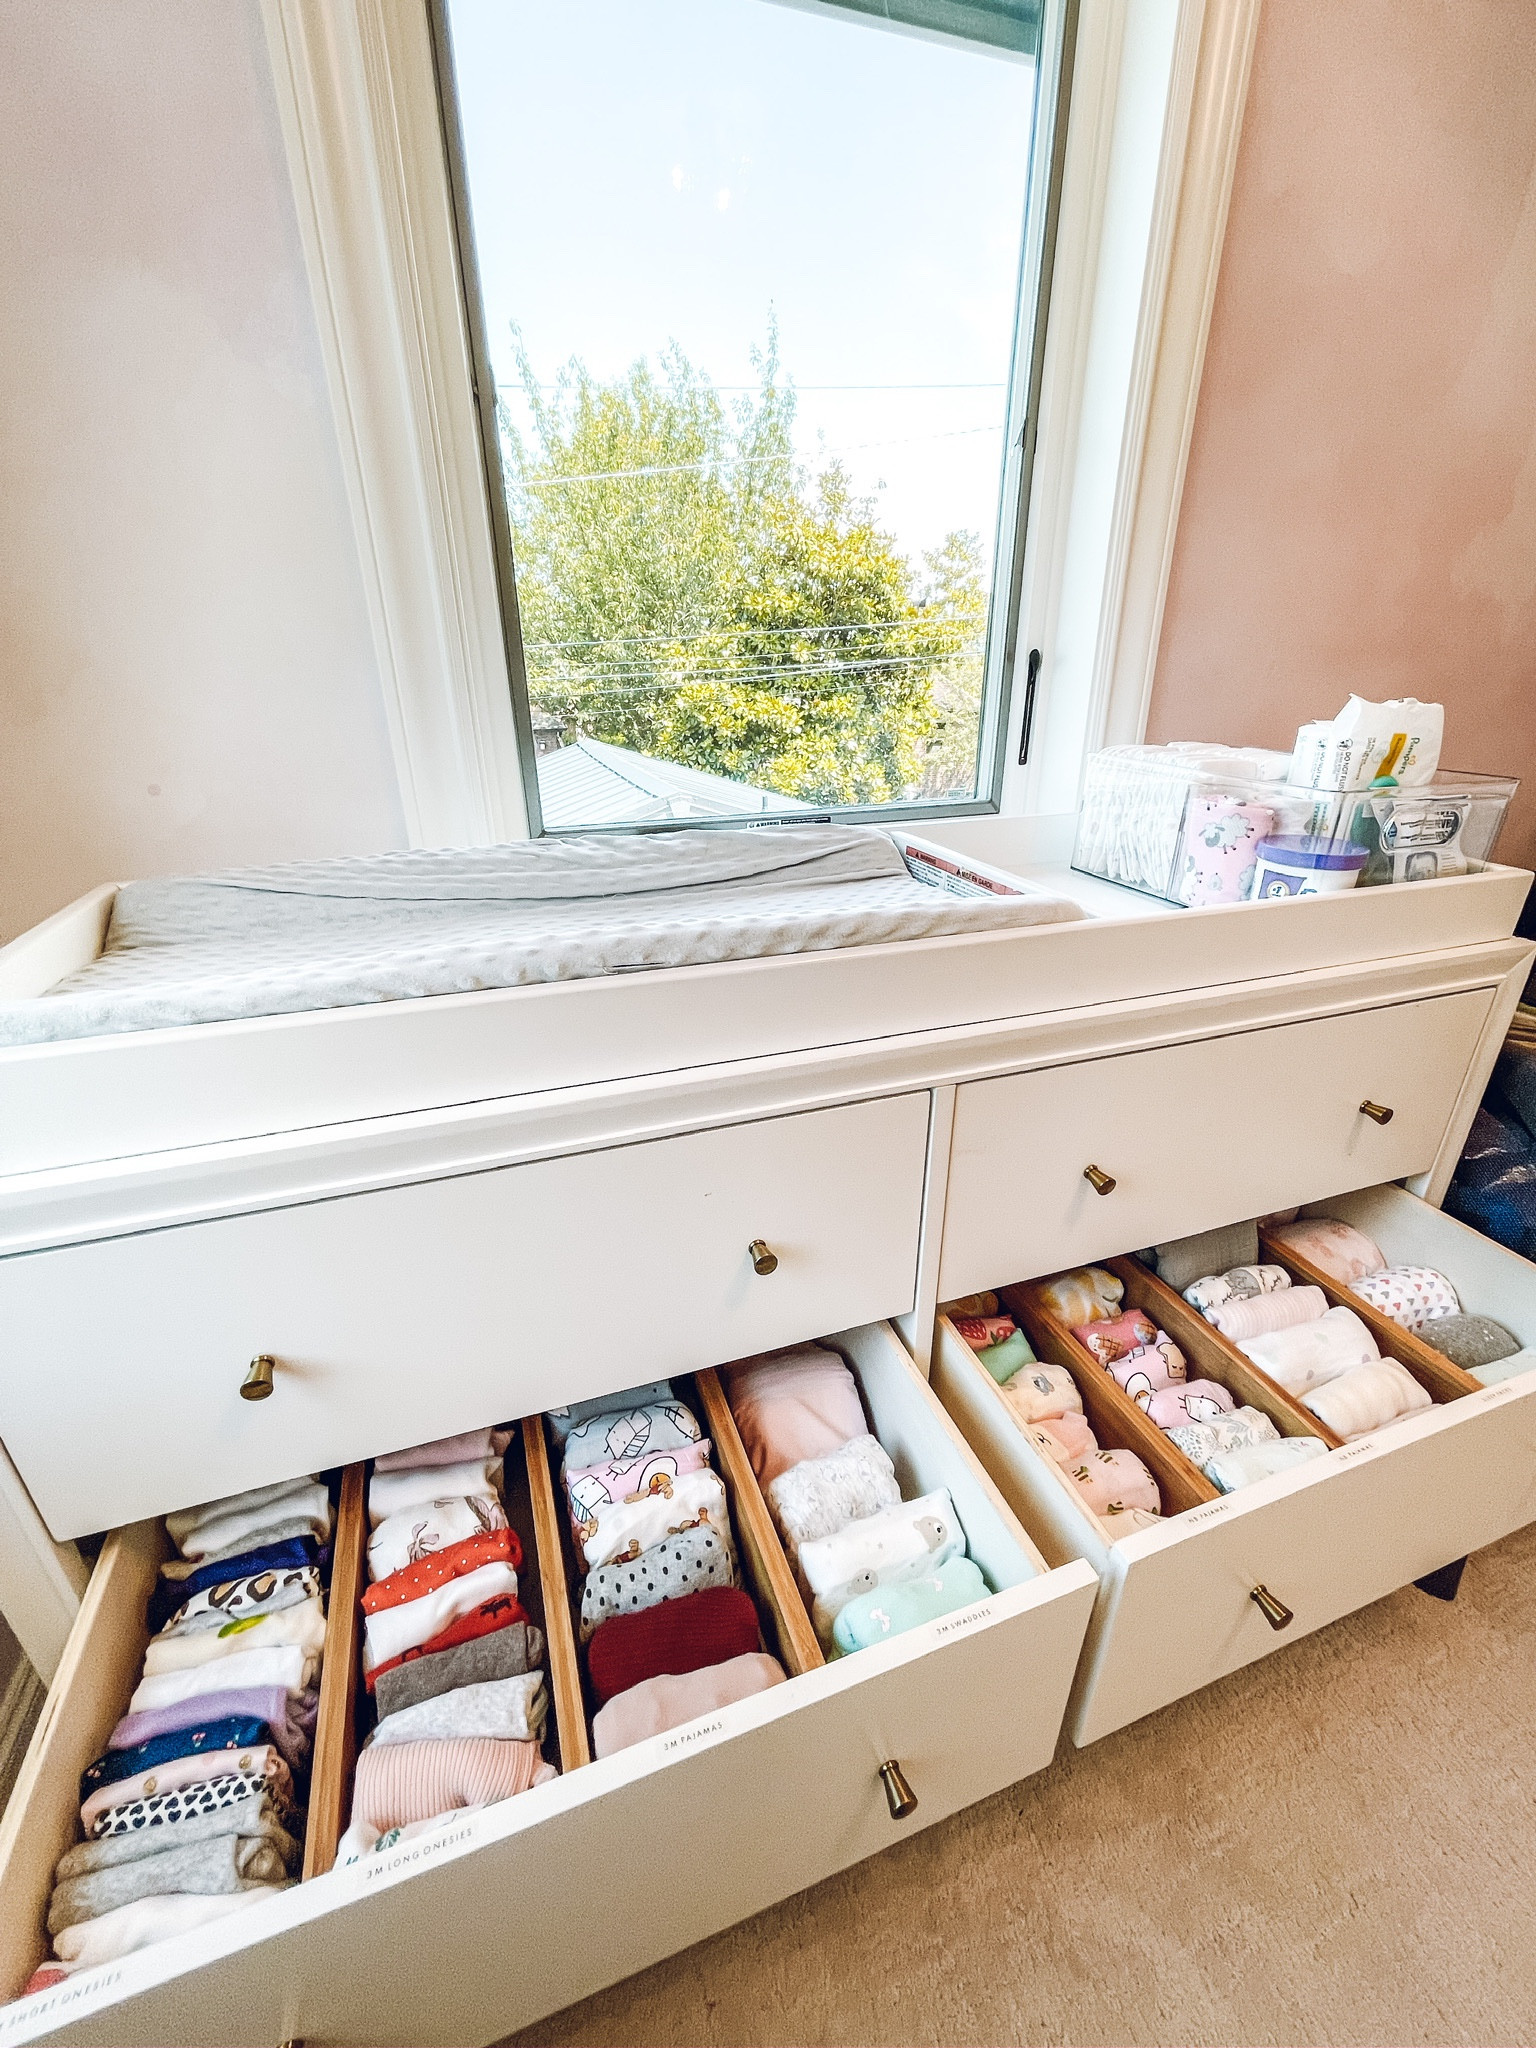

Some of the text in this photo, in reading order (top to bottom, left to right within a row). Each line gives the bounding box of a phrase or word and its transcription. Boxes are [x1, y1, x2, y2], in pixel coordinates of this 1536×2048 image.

[1344, 751, 1352, 761] DO
[1397, 737, 1421, 775] Pampers
[1340, 762, 1350, 776] NOT
[1312, 774, 1321, 789] FLUS
[1337, 776, 1347, 791] FLUS
[971, 875, 978, 883] EN
[1199, 1504, 1229, 1518] PAJAMAS
[950, 1608, 991, 1629] SWADDLES
[664, 1721, 723, 1751] 3M PAJAMAS
[367, 1827, 472, 1880] 3M LONG ONESIES
[8, 1968, 122, 2028] SHORT ONESIES
